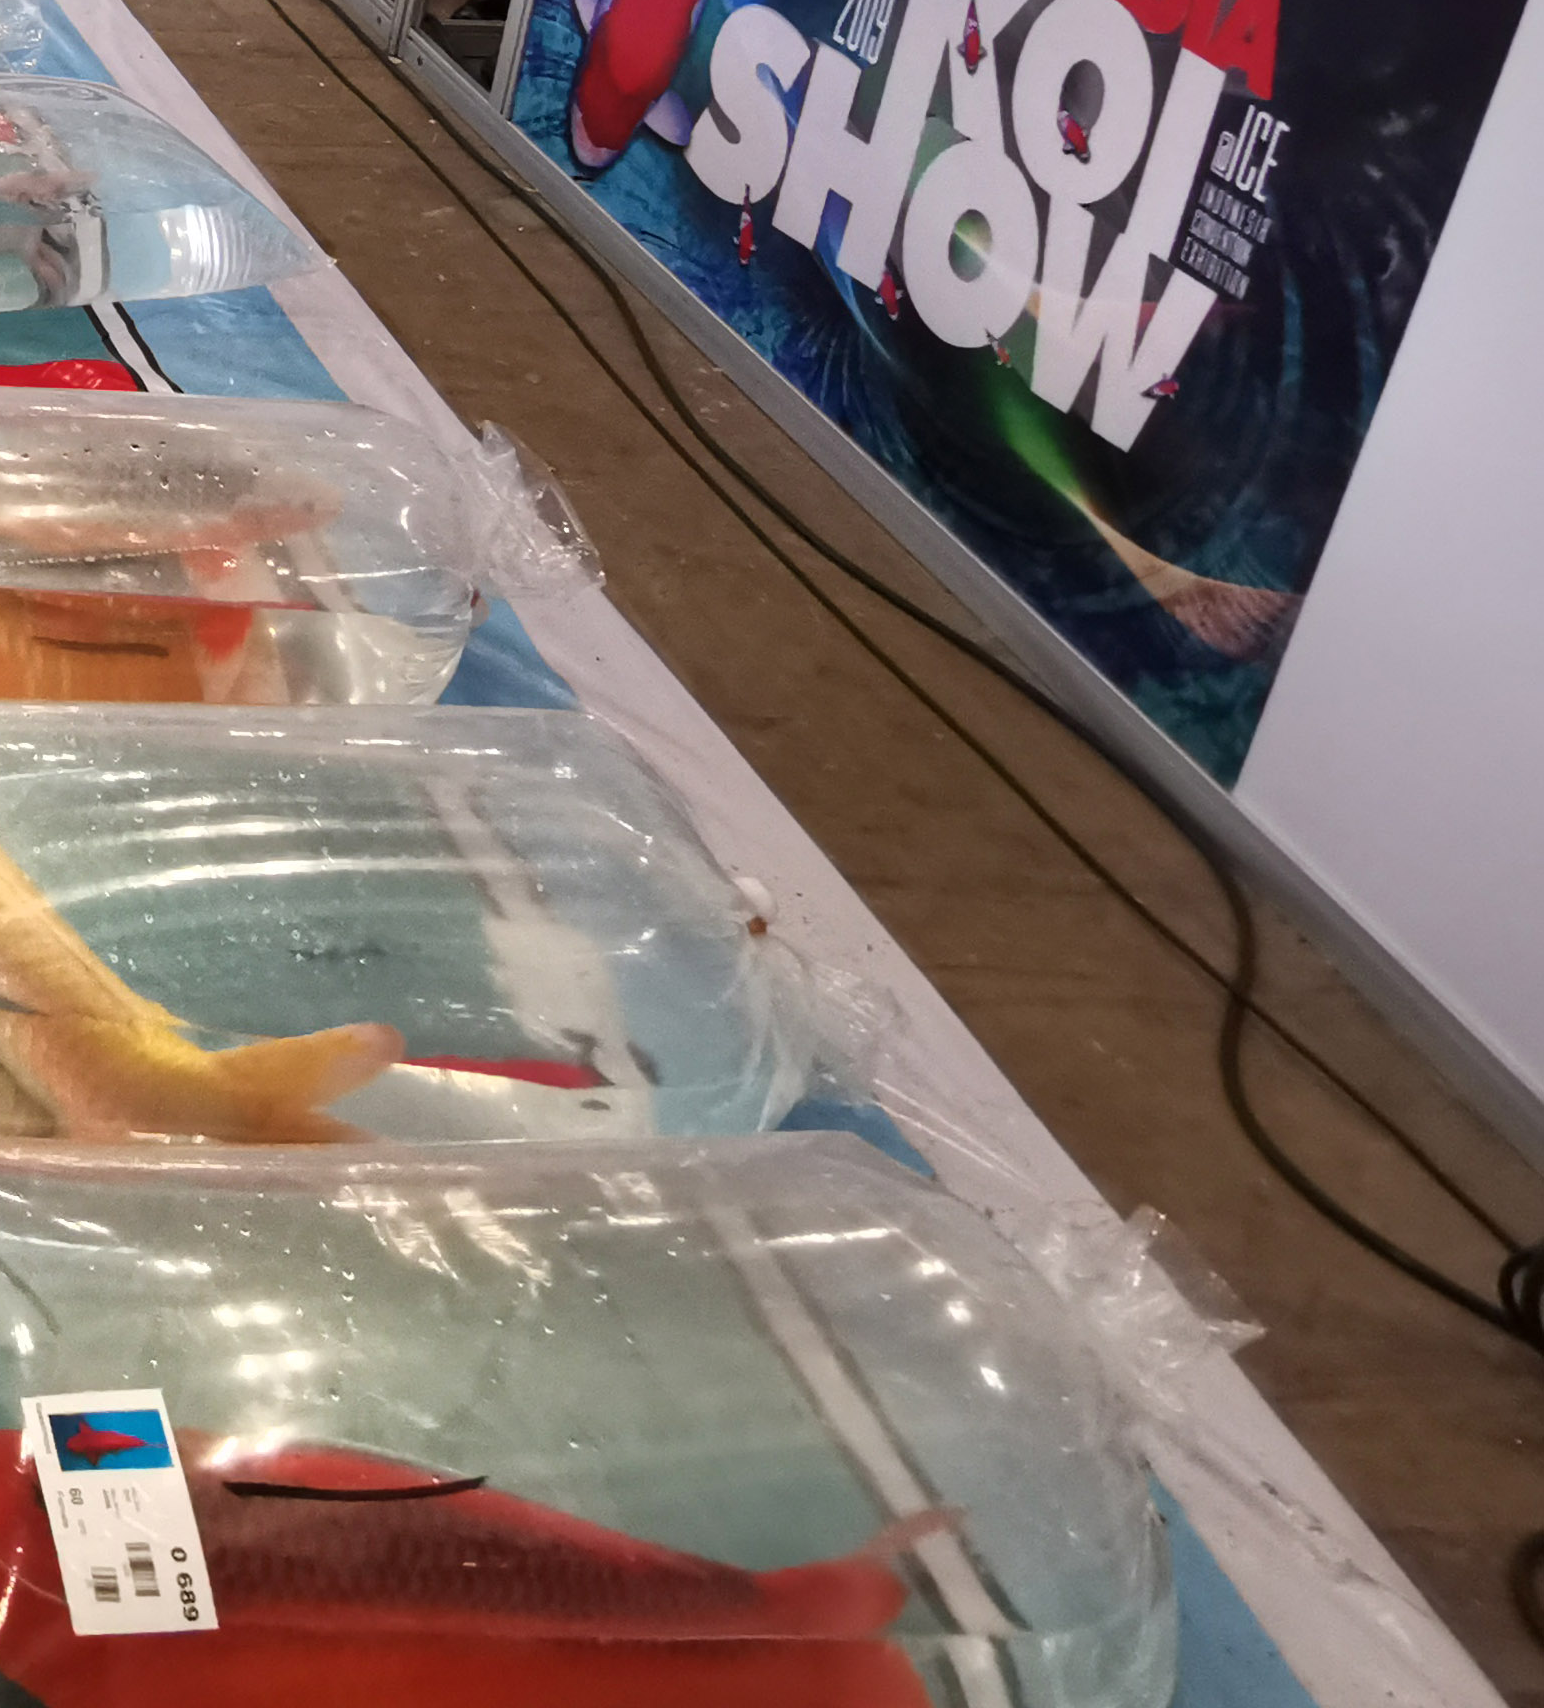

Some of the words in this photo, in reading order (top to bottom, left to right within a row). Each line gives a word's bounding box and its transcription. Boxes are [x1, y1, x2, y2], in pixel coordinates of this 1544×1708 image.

[685, 1, 1218, 454] SHOW
[170, 1547, 188, 1562] 0
[176, 1573, 200, 1623] 689
